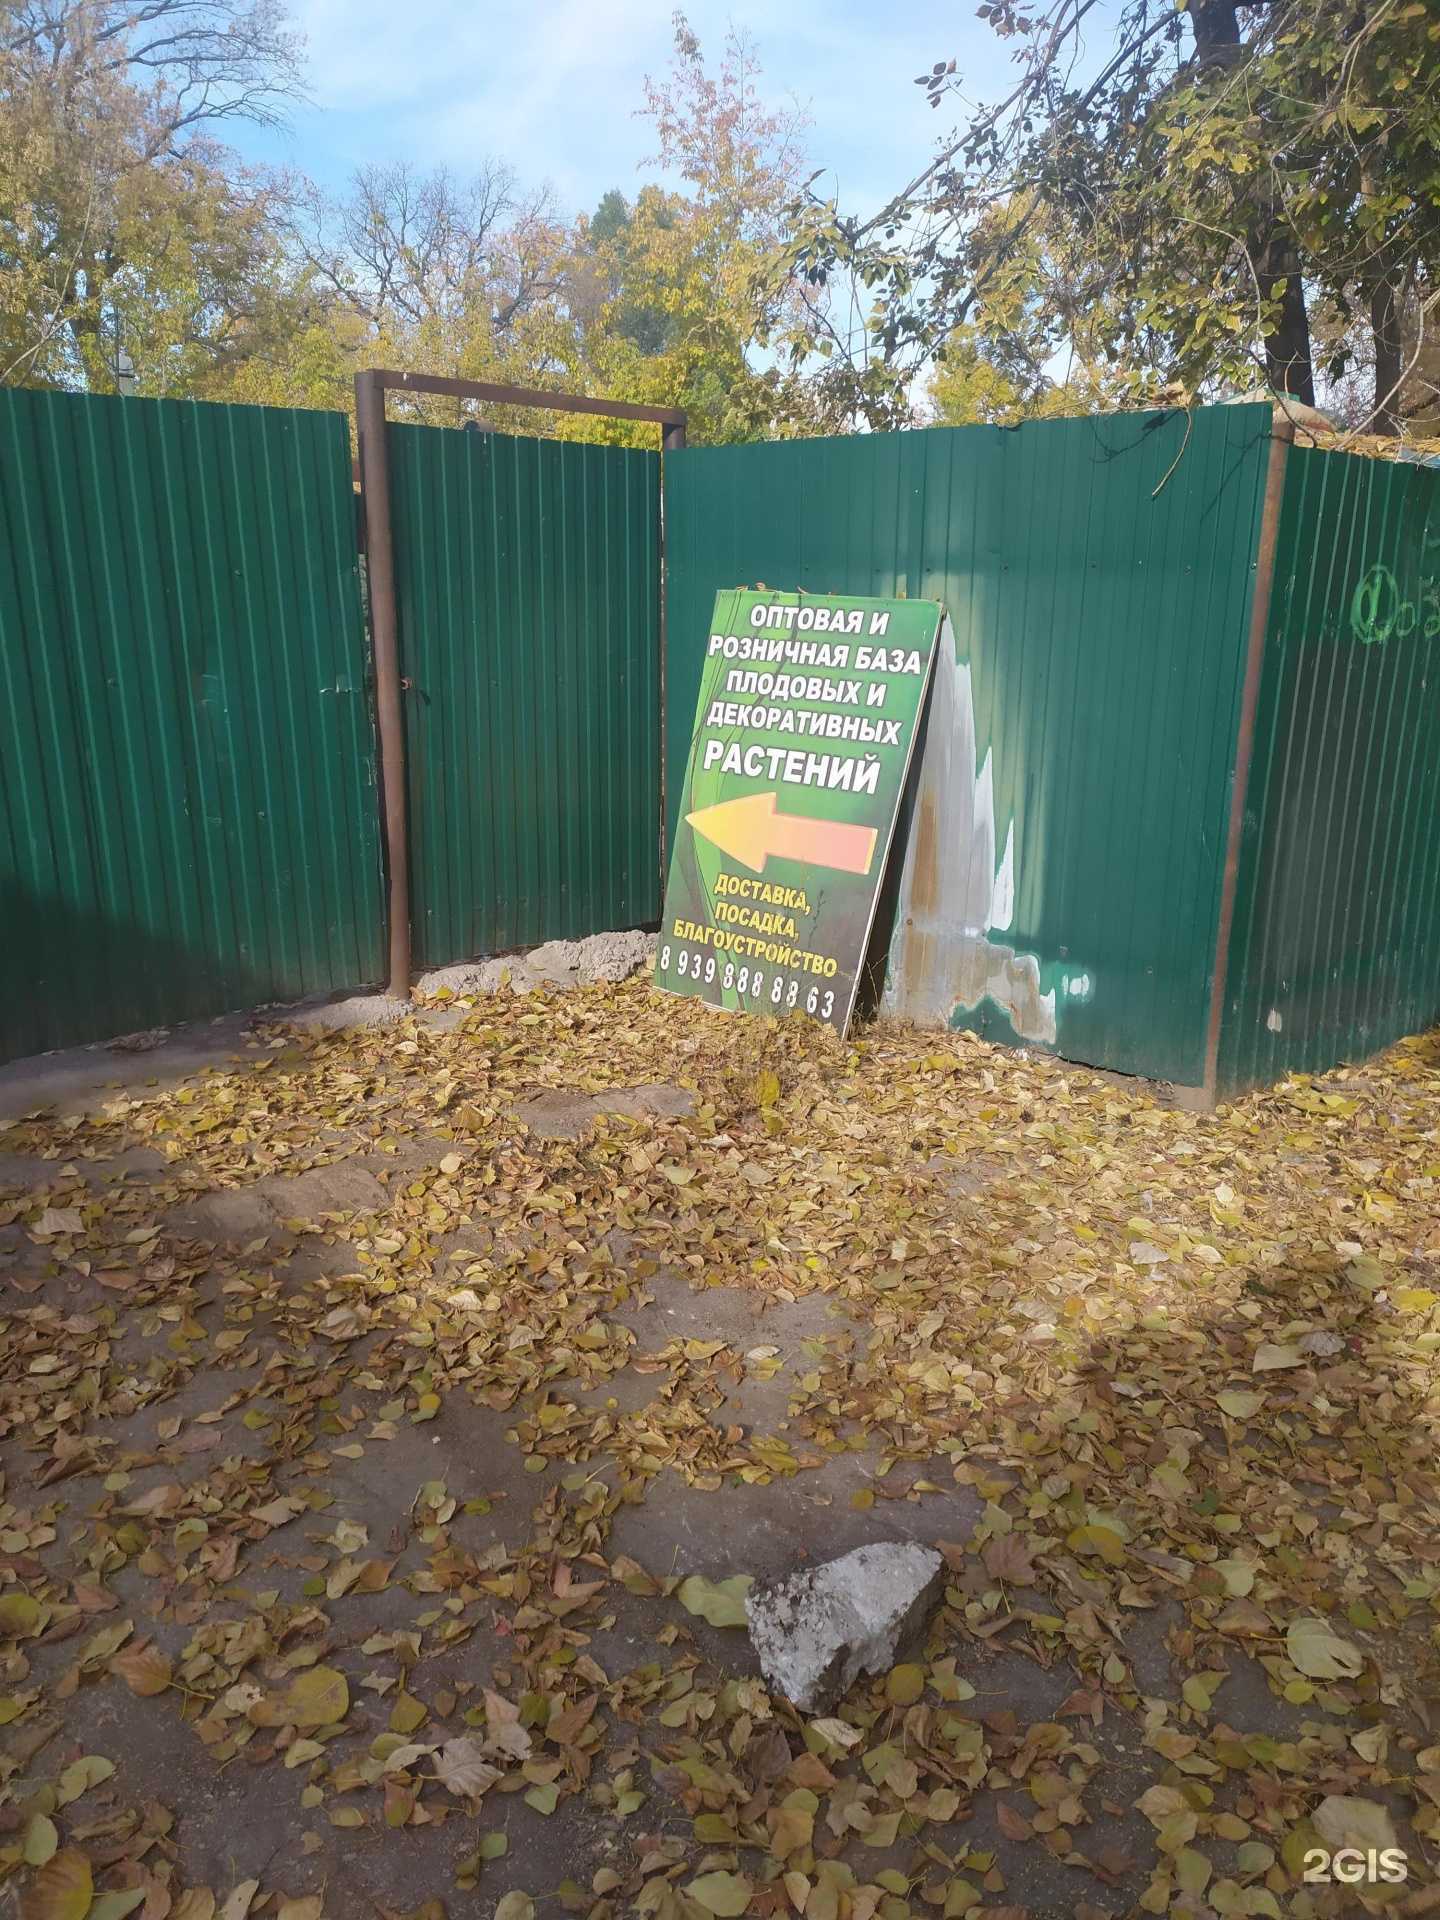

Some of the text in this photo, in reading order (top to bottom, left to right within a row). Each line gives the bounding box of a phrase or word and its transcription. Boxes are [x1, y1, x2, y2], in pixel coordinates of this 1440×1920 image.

[750, 605, 890, 636] ОПТОВАЯ И
[708, 635, 921, 675] РОЗНИЧНАЯ БАЗА
[726, 670, 887, 708] ПЛОДОВЫХ И
[706, 701, 902, 745] ДЕКОРАТИВНЫХ
[703, 740, 881, 795] РАСТЕНИЙ
[713, 873, 812, 916] ДОСТАВКА,
[714, 900, 800, 942] ПОСАДКА,
[673, 919, 838, 978] БЛАГОУСТРОЙСТВО
[660, 945, 835, 1019] 8 939 888 88 63
